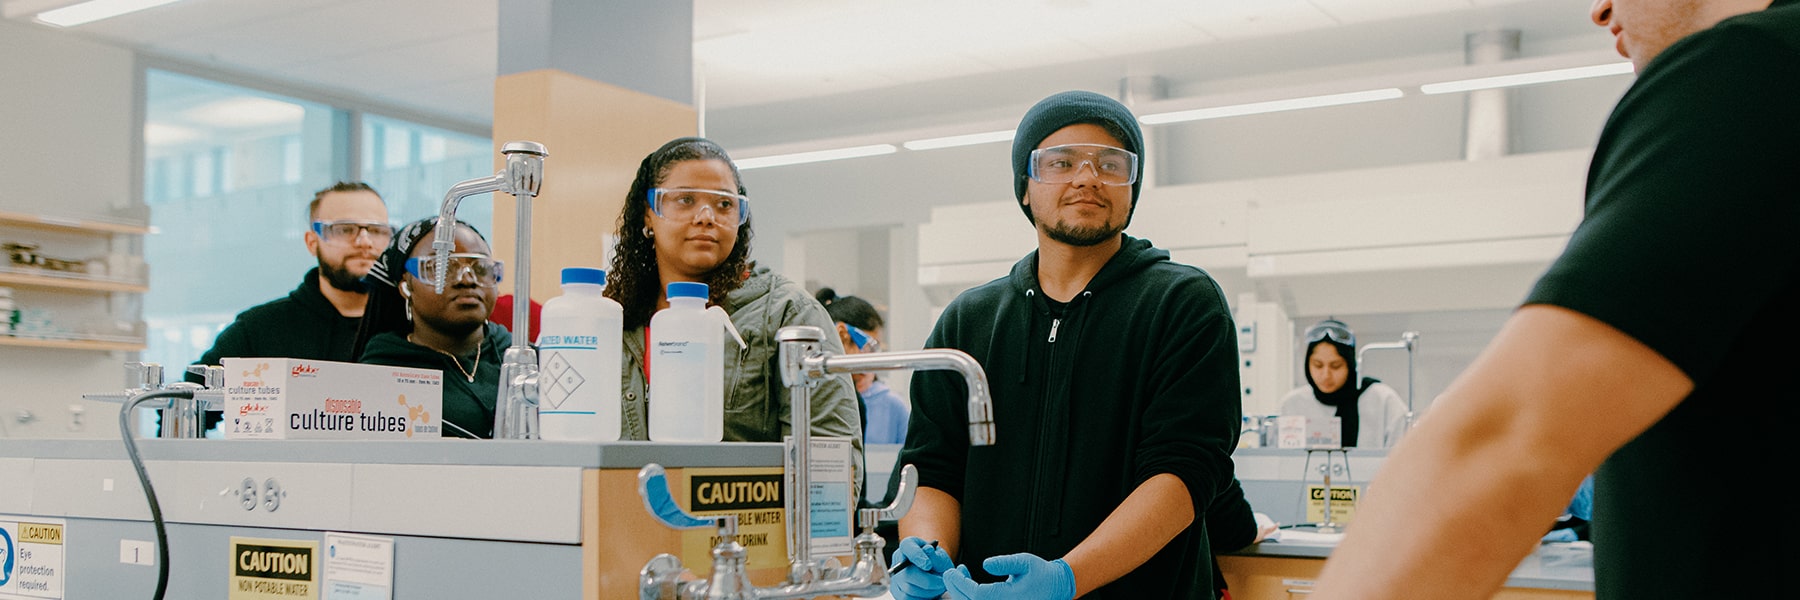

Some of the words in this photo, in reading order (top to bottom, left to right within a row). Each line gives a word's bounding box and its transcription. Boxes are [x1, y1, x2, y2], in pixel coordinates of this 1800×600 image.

[563, 335, 598, 345] WATER
[228, 385, 256, 395] culture
[258, 385, 280, 395] tubes
[290, 408, 354, 431] culture
[360, 411, 406, 432] tubes
[696, 481, 779, 504] CAUTION
[755, 512, 781, 525] WATER
[28, 526, 60, 540] CAUTION
[743, 532, 769, 547] DRINK
[20, 548, 32, 561] Eye
[239, 550, 308, 575] CAUTION
[20, 565, 54, 577] protection
[19, 580, 49, 592] required.
[238, 579, 253, 593] NON
[254, 580, 284, 596] POTABLE
[285, 583, 309, 597] WATER
